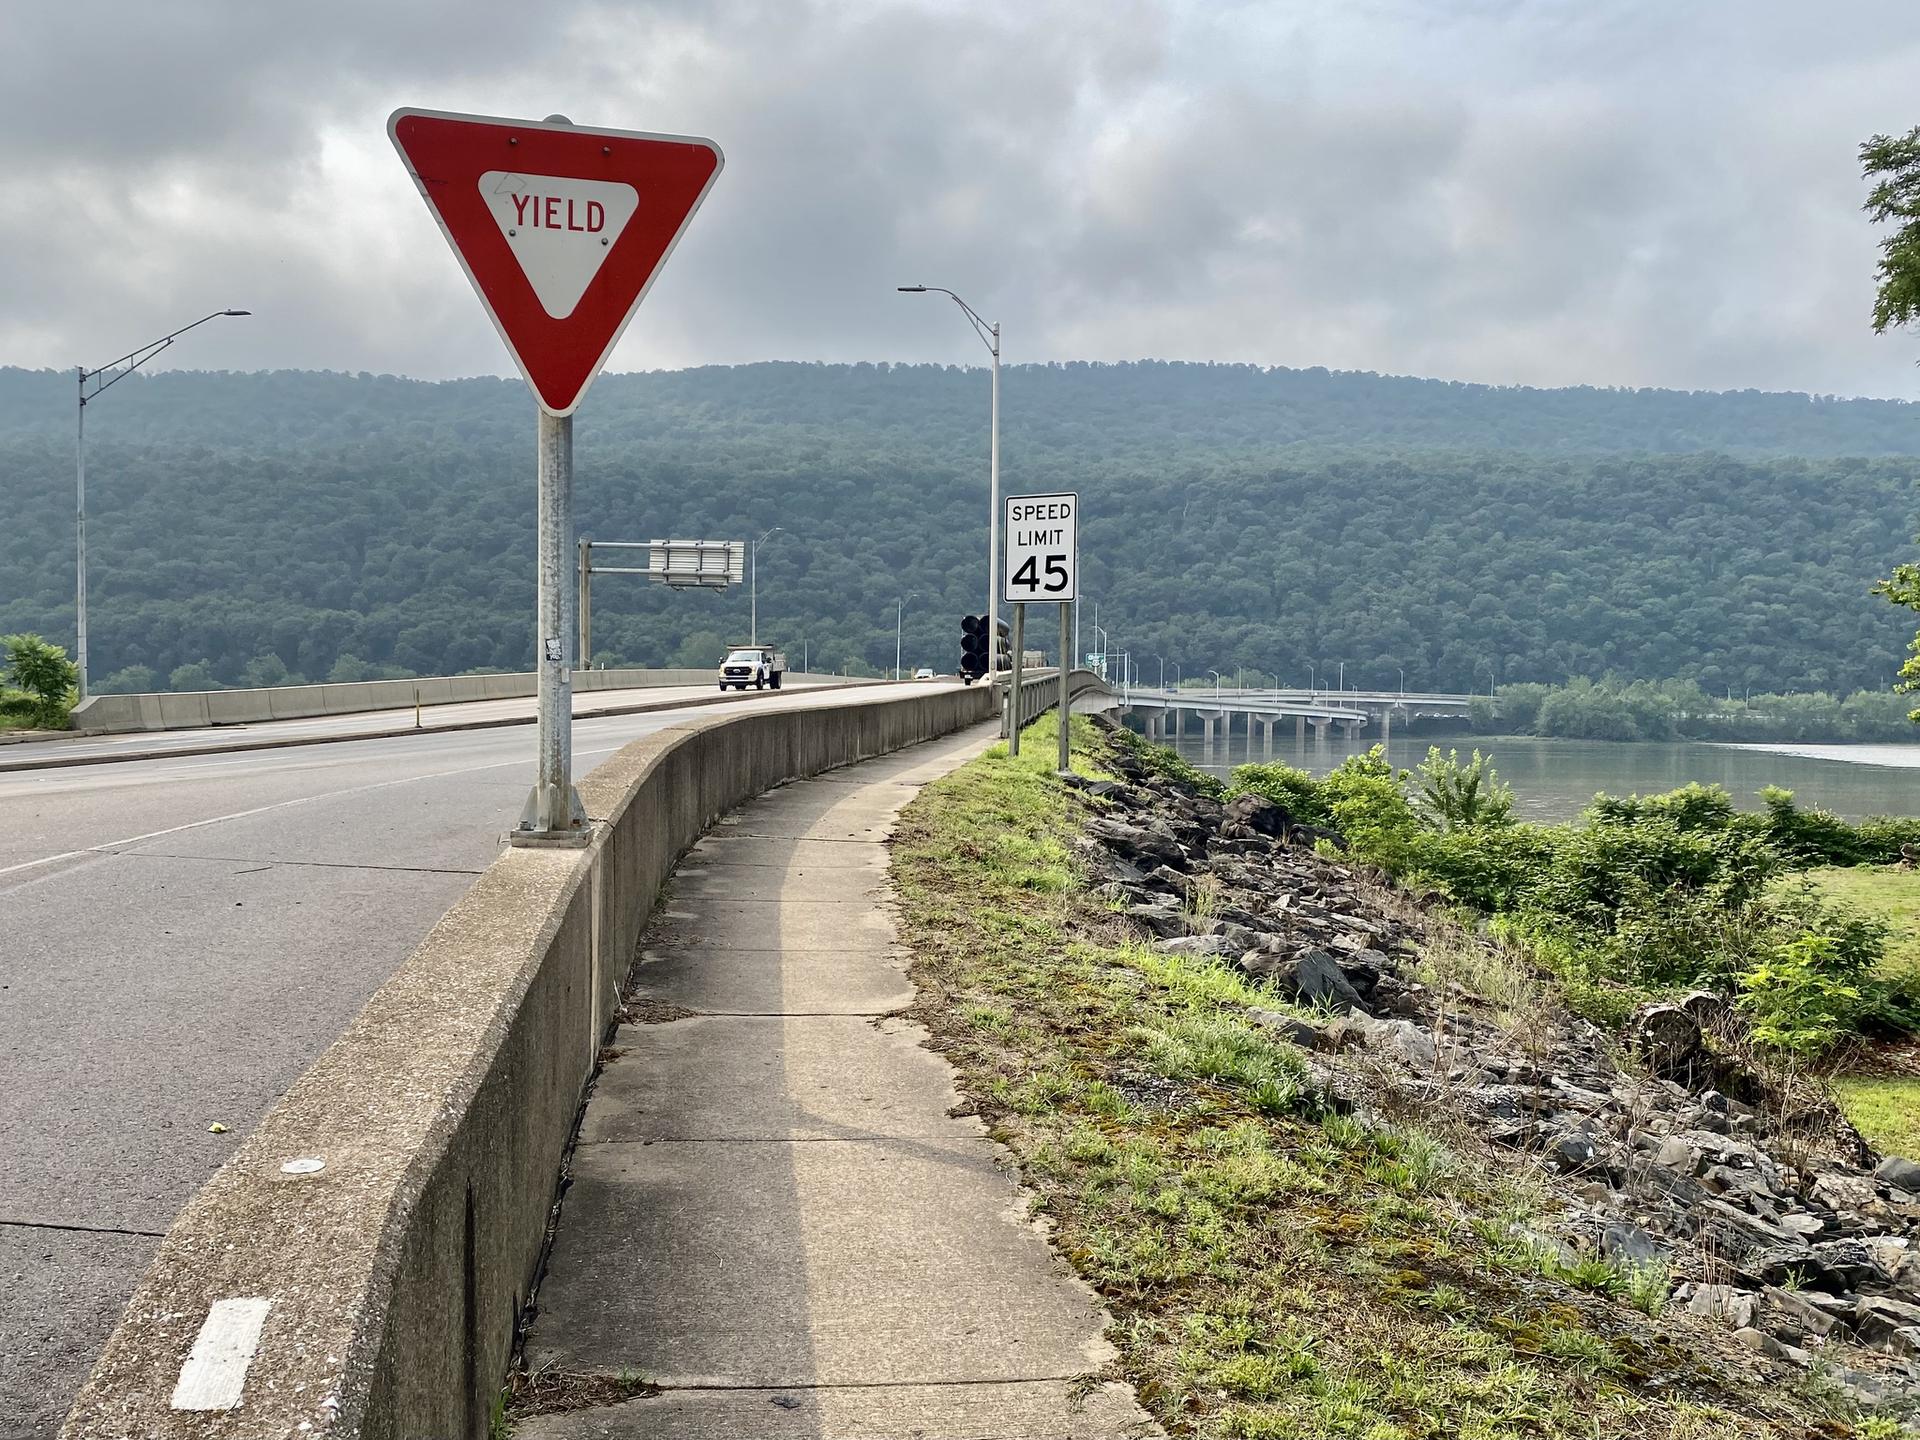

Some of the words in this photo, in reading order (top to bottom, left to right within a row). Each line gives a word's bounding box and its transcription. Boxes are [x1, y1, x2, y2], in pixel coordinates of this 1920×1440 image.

[511, 194, 605, 233] YIELD
[1012, 503, 1071, 521] SPEED
[1018, 529, 1064, 546] LIMIT
[1011, 554, 1069, 592] 45
